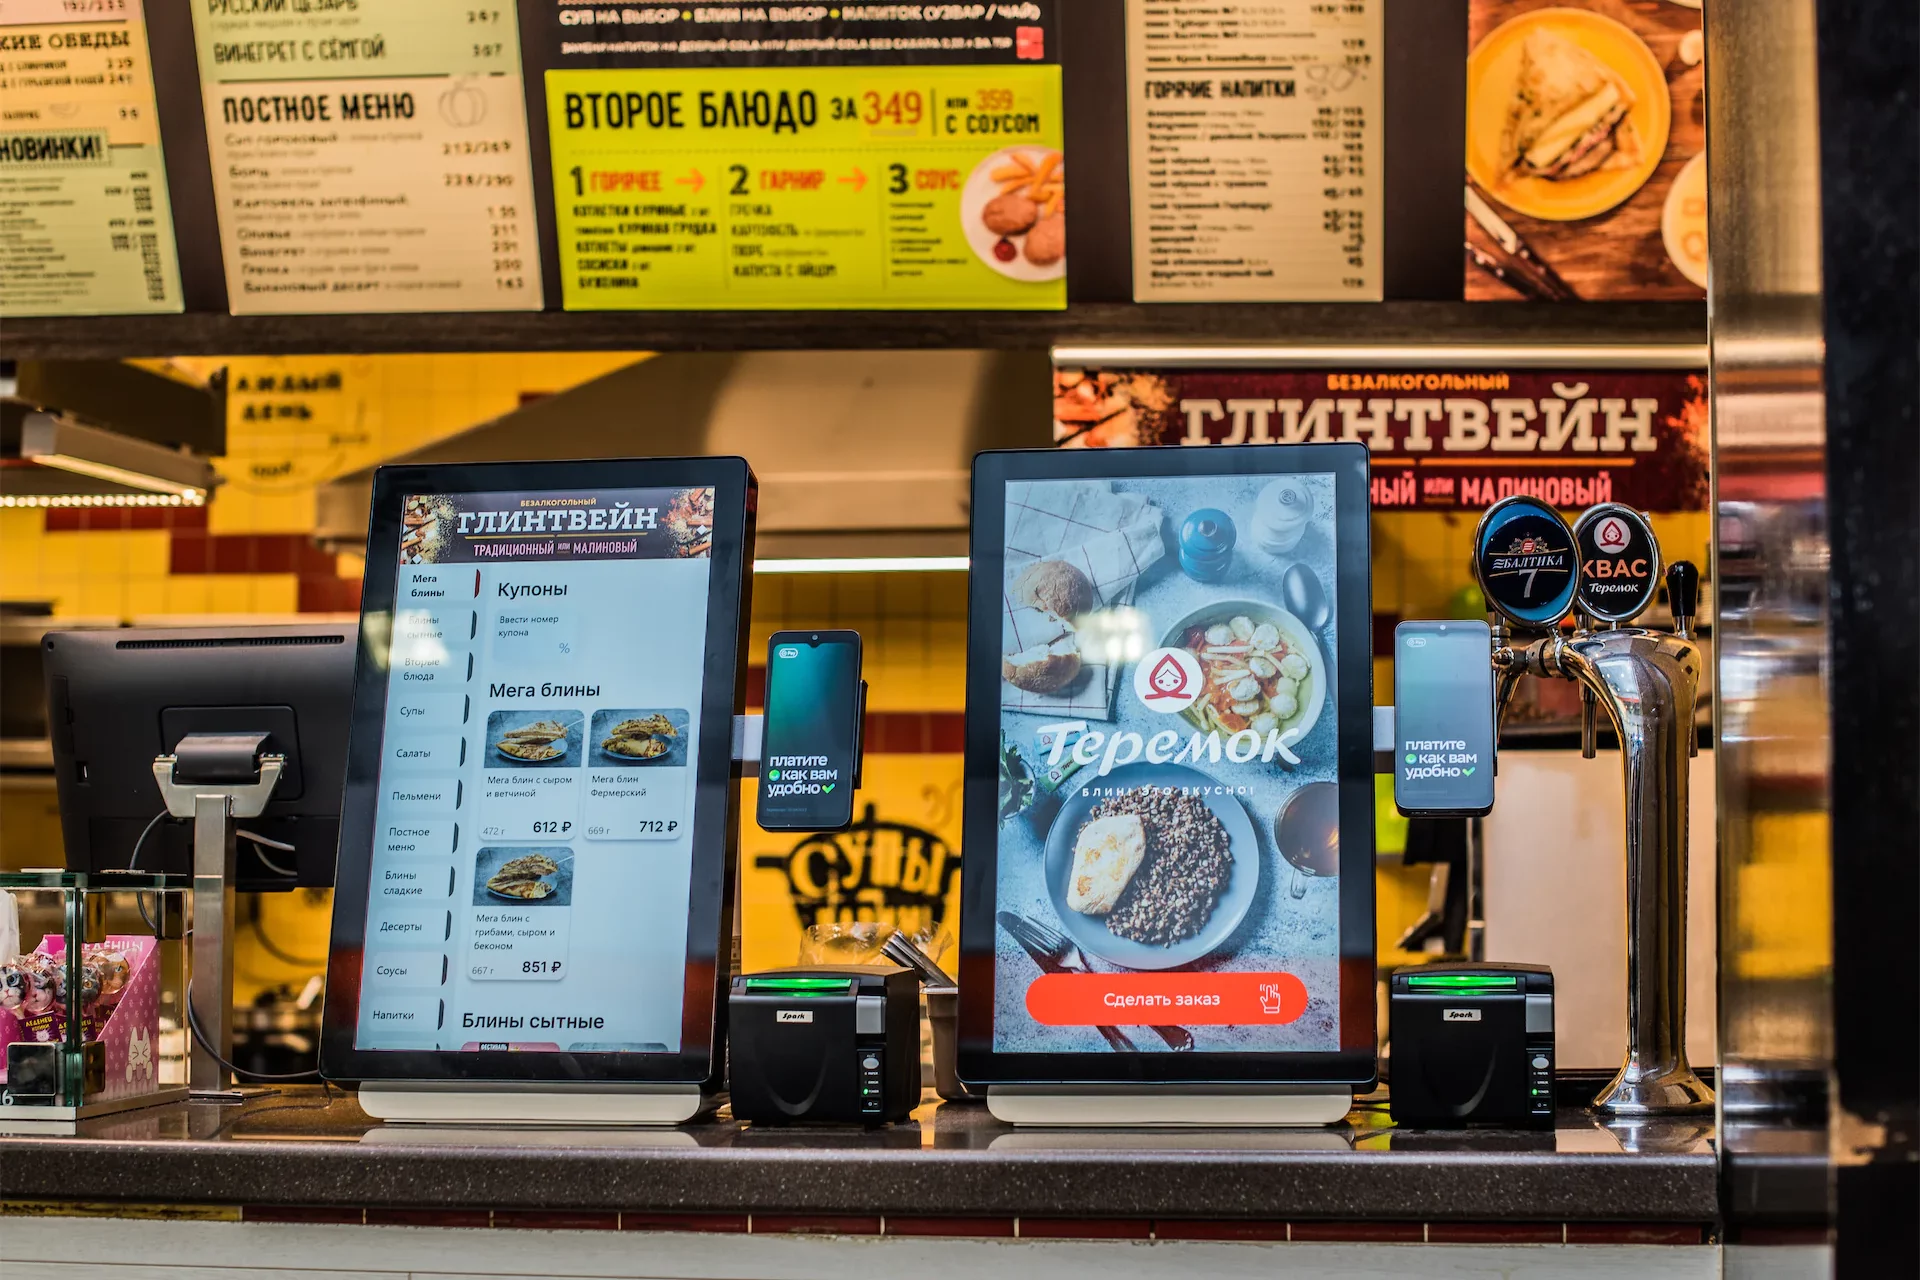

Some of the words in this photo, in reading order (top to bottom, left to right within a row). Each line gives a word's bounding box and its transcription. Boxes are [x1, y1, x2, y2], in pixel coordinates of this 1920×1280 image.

[48, 30, 131, 50] ОБЕДЫ
[213, 40, 298, 65] ВИНЕГРЕТ
[302, 40, 314, 61] С
[1145, 79, 1214, 99] ГОРЯЧИЕ
[1221, 79, 1296, 98] НАПИТКИ
[974, 88, 1014, 111] 359
[223, 94, 330, 123] ПОСТНОЕ
[341, 92, 416, 119] МЕНЮ
[564, 91, 686, 130] ВТОРОЕ
[699, 89, 818, 135] БЛЮДО
[830, 97, 858, 121] ЗА
[863, 90, 923, 126] 349
[945, 115, 958, 134] С
[966, 114, 1041, 134] СОУСОМ
[569, 164, 585, 197] 1
[590, 170, 663, 193] ГОРЯЧЕЕ
[729, 163, 750, 196] 2
[759, 169, 827, 192] ГАРНИР
[888, 162, 909, 195] 3
[915, 169, 961, 191] СОУС
[1326, 374, 1510, 391] БЕЗАЛКОГОЛЬНЫЙ
[1179, 381, 1659, 452] ГЛИНТВЕЙН
[1423, 477, 1455, 495] ИЛИ
[1460, 471, 1612, 506] МАЛИНОВЫЙ
[520, 497, 597, 508] БЕЗАЛКОГОЛЬНЫЙ
[456, 501, 660, 534] ГЛИНТВЕЙН
[473, 541, 555, 557] ТРАДИЦИОННЫЙ
[557, 542, 571, 551] ИЛИ
[573, 541, 638, 555] МАЛИНОВЫЙ
[1503, 554, 1564, 569] БАЛТИКА
[412, 573, 438, 585] Мега
[1518, 568, 1539, 598] 7
[411, 587, 445, 598] блины
[498, 582, 568, 600] Купоны
[1588, 582, 1639, 596] Теремок
[408, 615, 440, 625] Блины
[499, 615, 529, 625] Ввести
[530, 616, 559, 626] номер
[407, 630, 443, 640] сытные
[498, 629, 529, 639] купона
[404, 657, 440, 668] Вторые
[403, 671, 435, 682] блюда
[489, 683, 536, 699] Мега
[540, 682, 601, 698] блины
[400, 706, 426, 718] Супы
[1036, 720, 1302, 777] Теремок
[1405, 740, 1467, 751] платите
[396, 748, 431, 759] Салаты
[1419, 753, 1446, 764] как
[1449, 753, 1478, 764] вам
[769, 755, 828, 767] платите
[781, 769, 807, 780] как
[810, 769, 838, 780] вам
[1405, 764, 1461, 780] удобно
[487, 775, 511, 786] Мега
[513, 775, 533, 785] блин
[543, 776, 573, 787] сыром
[592, 775, 614, 785] Мега
[616, 775, 639, 784] блин
[486, 790, 492, 798] и
[494, 788, 537, 798] ветчиной
[590, 788, 647, 799] Фермерский
[768, 780, 821, 798] удобно
[1141, 786, 1172, 797] ЭТО
[1182, 785, 1254, 798] ВКУСНО!
[392, 791, 442, 802] Пельмени
[389, 827, 431, 838] Постное
[483, 826, 499, 836] 472
[532, 821, 558, 834] 612
[562, 821, 572, 833] ₽
[588, 826, 605, 836] 669
[639, 820, 663, 833] 712
[667, 820, 678, 833] ₽
[388, 843, 416, 852] меню
[790, 829, 947, 898] СУПЫ
[385, 870, 417, 881] Блины
[384, 885, 423, 897] сладкие
[476, 913, 499, 924] Мега
[501, 913, 523, 923] блин
[380, 921, 423, 933] Десерты
[475, 927, 515, 939] грибами,
[517, 928, 547, 940] сыром
[549, 928, 556, 936] и
[474, 941, 513, 951] беконом
[376, 965, 408, 977] Соусы
[472, 966, 488, 976] 667
[522, 961, 548, 973] 851
[551, 961, 562, 973] ₽
[1103, 991, 1171, 1008] Сделать
[1175, 994, 1221, 1007] заказ
[372, 1010, 415, 1021] Напитки
[462, 1012, 524, 1029] Блины
[529, 1015, 605, 1029] сытные
[782, 1012, 806, 1020] Spark
[1447, 1011, 1474, 1019] Spark
[25, 1016, 53, 1028] ЛЕДЕНЕЦ
